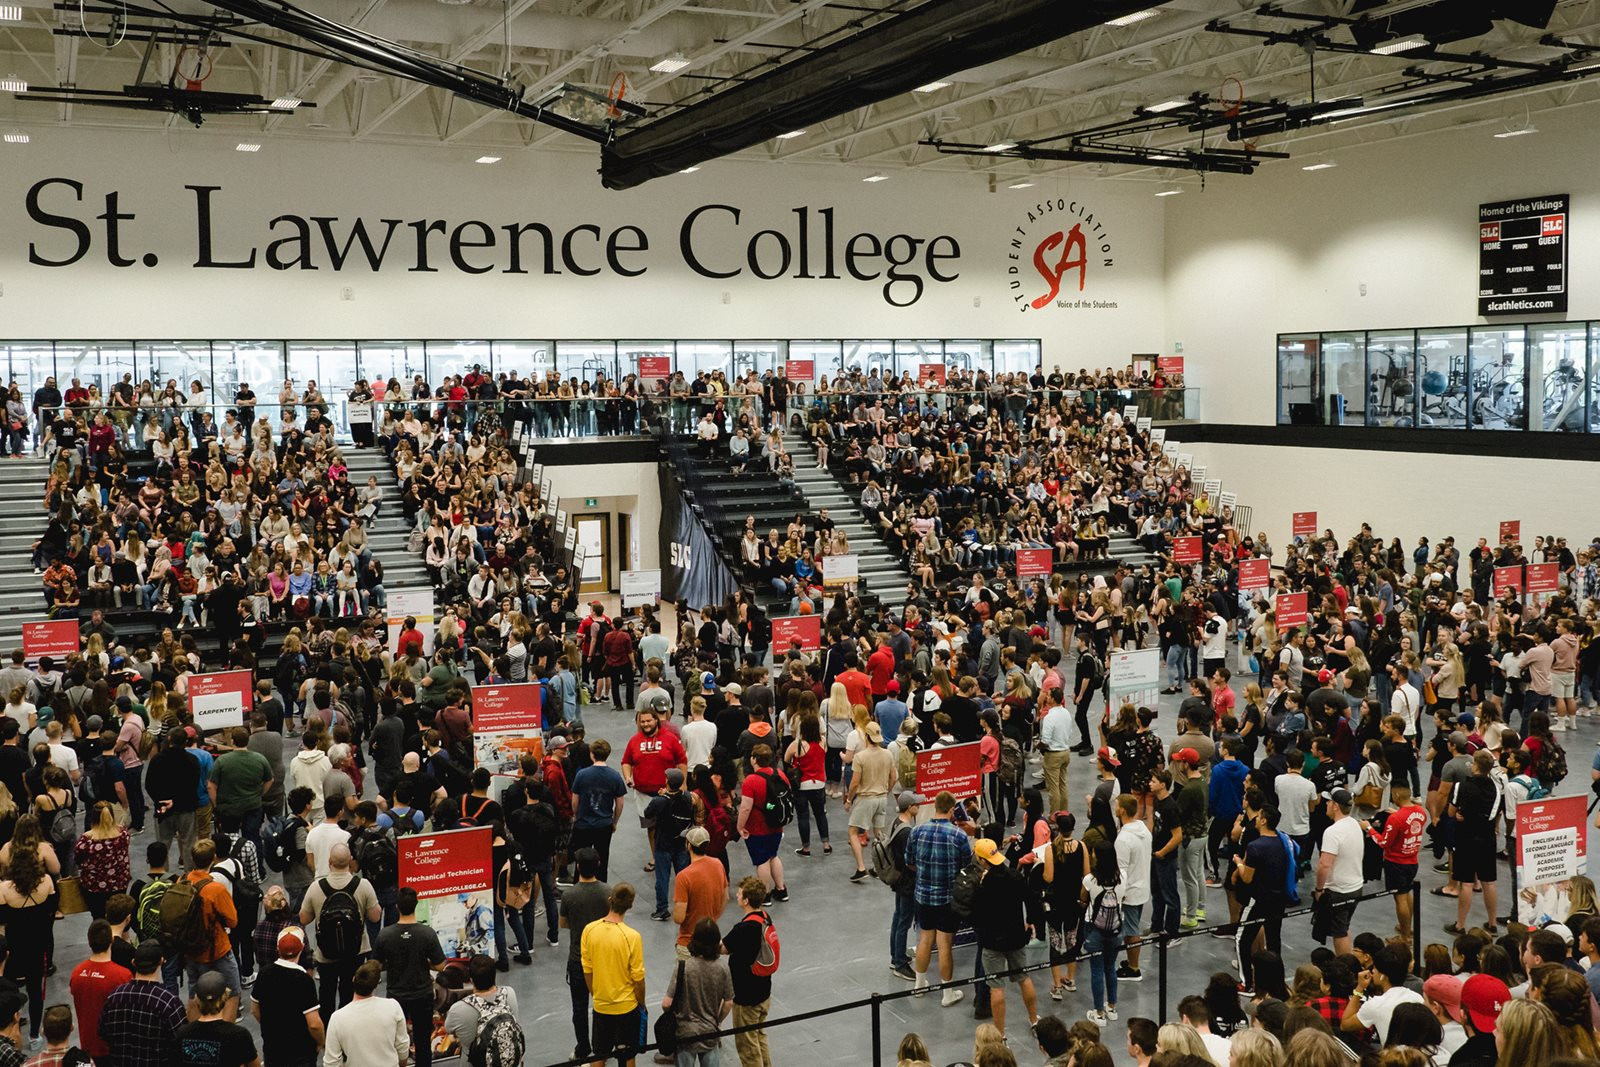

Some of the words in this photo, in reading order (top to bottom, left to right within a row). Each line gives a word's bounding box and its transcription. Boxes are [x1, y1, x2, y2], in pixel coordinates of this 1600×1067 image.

[1481, 207, 1504, 217] Home
[1506, 205, 1514, 214] of
[1516, 203, 1529, 213] the
[1531, 200, 1563, 211] Vikings
[1543, 220, 1562, 232] SLC
[1481, 227, 1498, 238] SLC
[26, 178, 158, 267] St.
[185, 185, 648, 276] Lawrence
[680, 205, 960, 306] College
[1538, 236, 1560, 246] GUEST
[1483, 242, 1501, 251] HOME
[1009, 226, 1030, 312] STUDENT
[1028, 199, 1113, 267] ASSOCIATION
[1057, 300, 1073, 309] Voice
[1074, 300, 1081, 309] of
[1082, 300, 1091, 308] the
[1093, 300, 1118, 309] Students
[1488, 300, 1553, 311] slcathletics.com
[671, 542, 691, 570] SLC
[198, 706, 238, 716] CARPENTRY
[640, 741, 662, 751] SLC
[954, 774, 977, 782] Engineering
[1529, 814, 1555, 823] Lawrence
[1529, 823, 1549, 831] College
[1532, 837, 1554, 845] ENGLISH
[1525, 844, 1546, 853] SECOND
[1547, 841, 1574, 850] LANGUAGE
[405, 851, 414, 859] St.
[415, 848, 449, 857] Lawrence
[1533, 851, 1555, 859] ENGLISH
[414, 857, 441, 865] College
[1537, 857, 1564, 866] ACADEMIC
[1537, 864, 1565, 872] PURPOSES
[406, 873, 445, 882] Mechanical
[447, 868, 484, 877] Technician
[1535, 870, 1567, 880] CERTIFICATE
[417, 882, 486, 896] AWRENCECOLLEGE.CA
